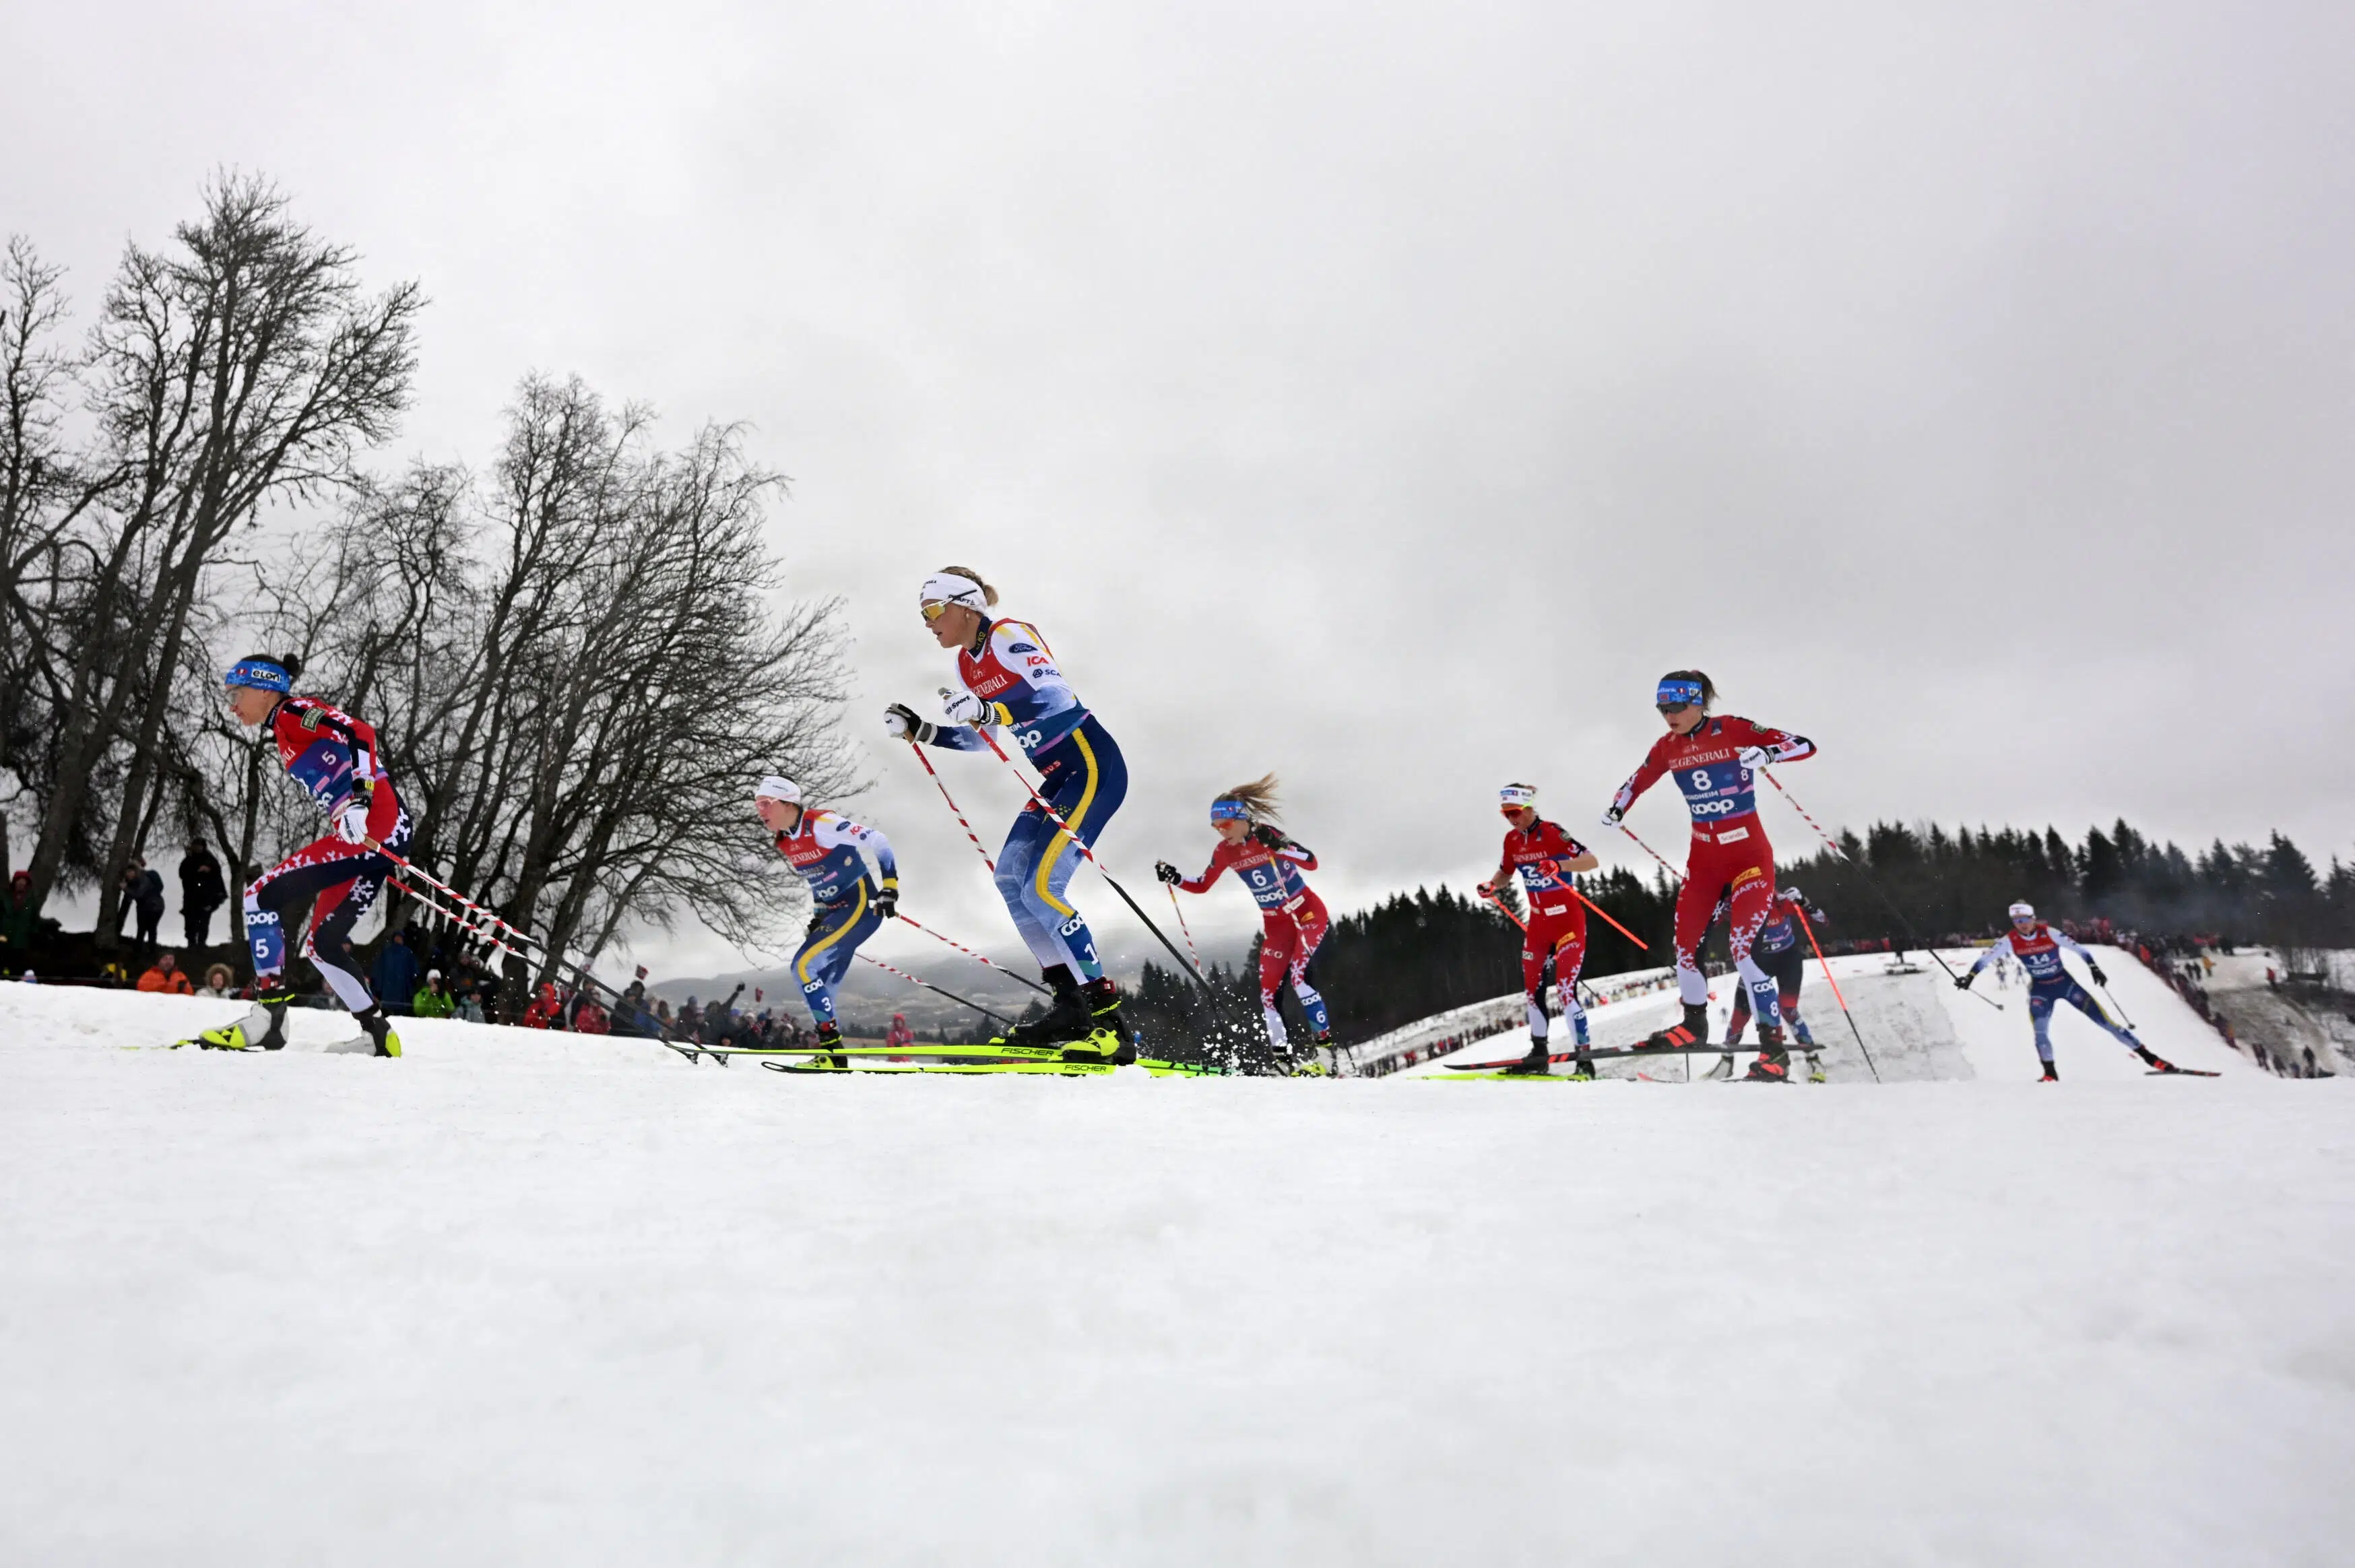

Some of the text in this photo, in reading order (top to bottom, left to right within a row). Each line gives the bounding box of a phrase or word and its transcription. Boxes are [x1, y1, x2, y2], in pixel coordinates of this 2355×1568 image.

[1027, 655, 1050, 667] ICA
[321, 750, 337, 765] 5
[1678, 748, 1730, 766] GENERALI
[1691, 769, 1712, 791] 8
[1741, 769, 1749, 781] 8
[1691, 799, 1735, 814] coop
[1283, 860, 1291, 870] 6
[1251, 869, 1267, 886] 6
[247, 911, 279, 925] oop
[255, 938, 269, 958] 5
[1084, 943, 1099, 965] 1
[2030, 954, 2050, 965] 14
[821, 997, 832, 1012] 3
[1770, 1002, 1779, 1017] 8
[1316, 1011, 1326, 1024] 6
[1000, 1047, 1054, 1056] FISCHER
[1064, 1064, 1107, 1072] FISCHER
